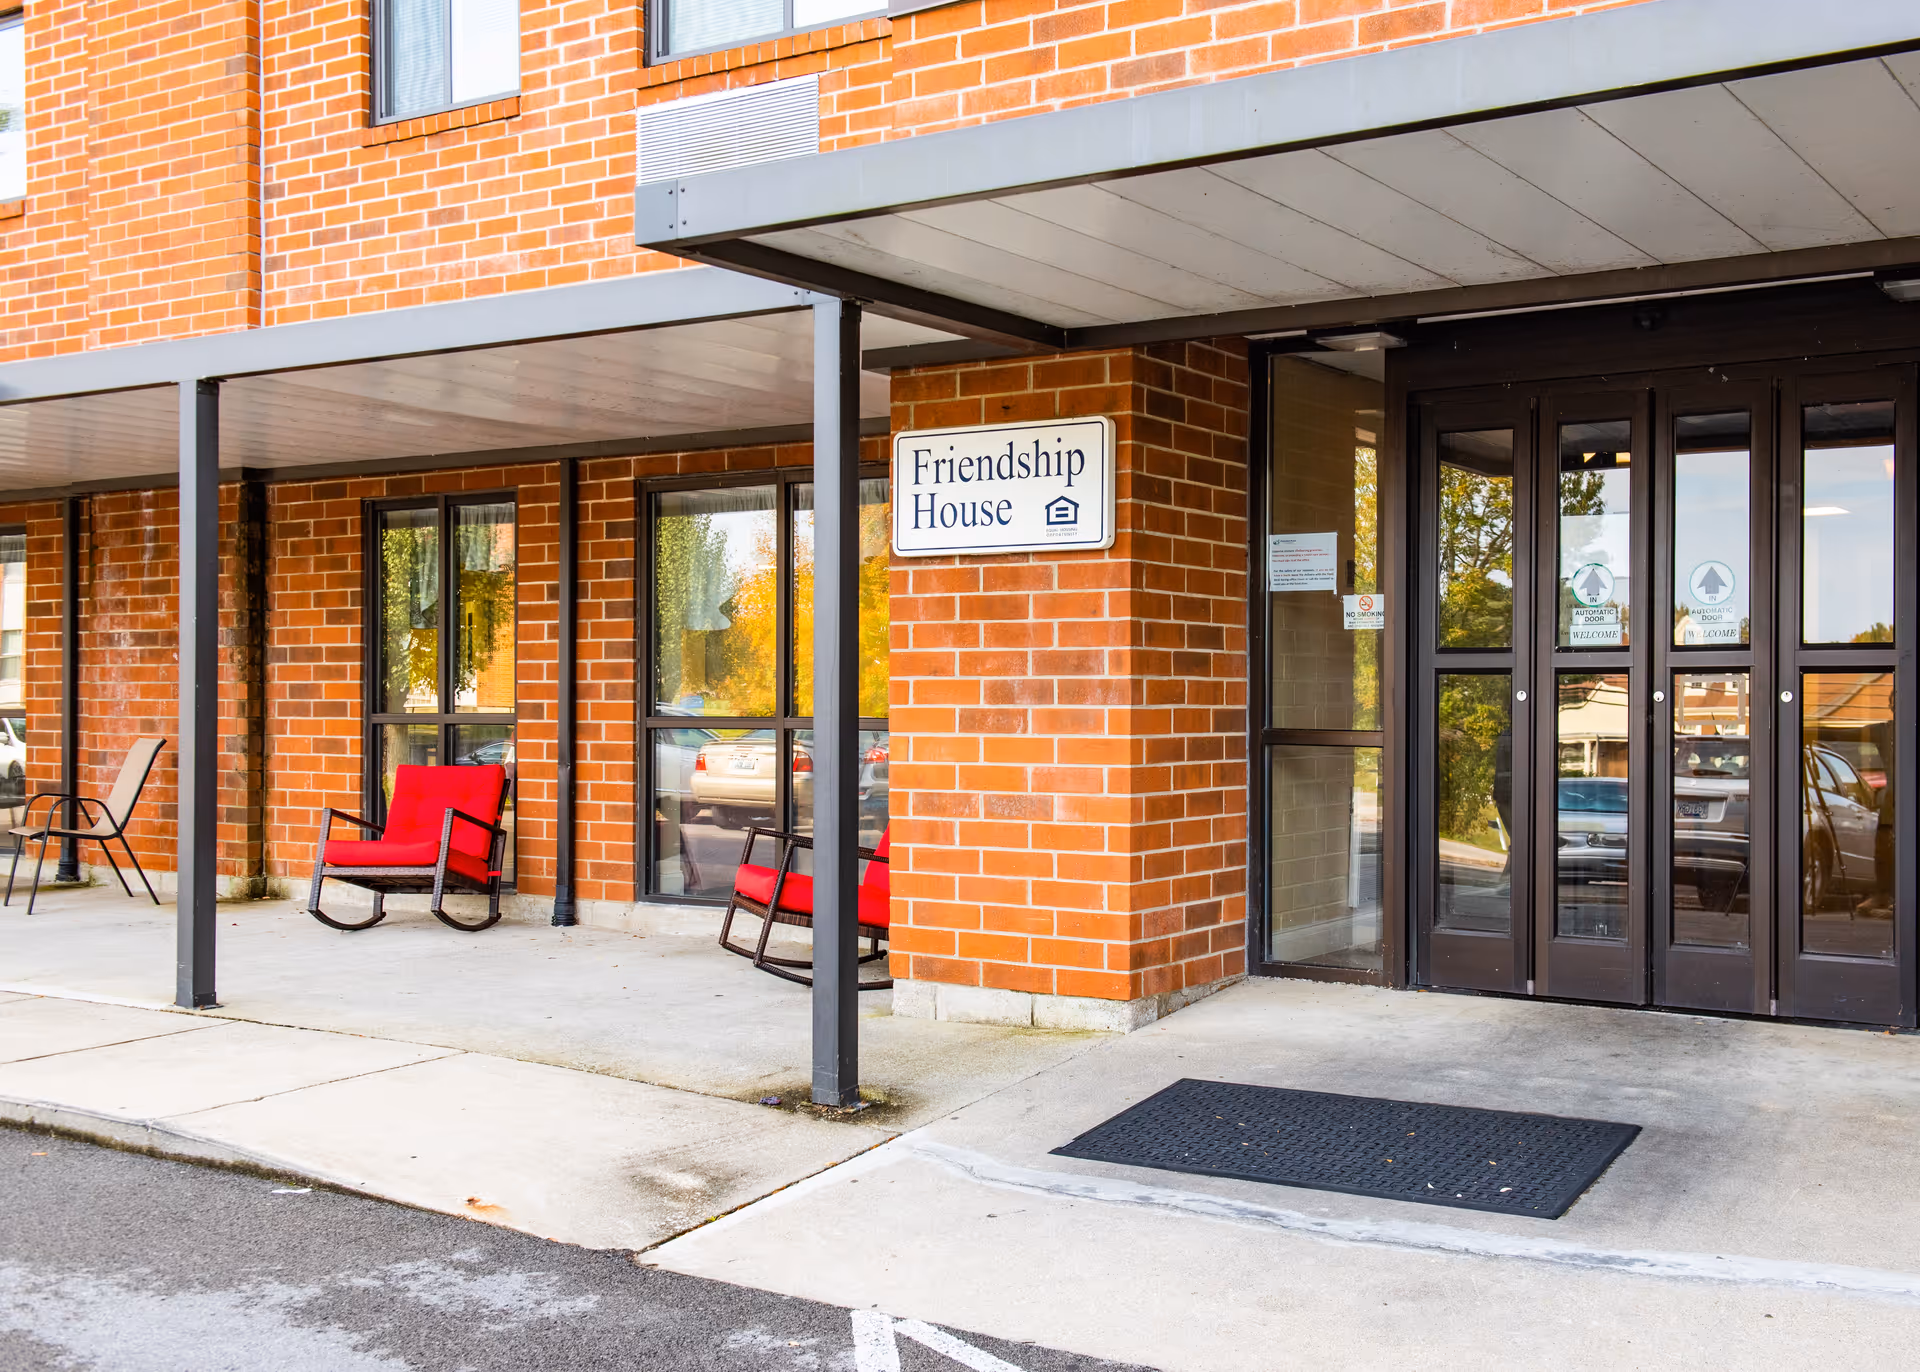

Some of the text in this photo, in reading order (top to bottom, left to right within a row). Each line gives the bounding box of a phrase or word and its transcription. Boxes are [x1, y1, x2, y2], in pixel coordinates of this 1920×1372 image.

[911, 437, 1085, 487] Friendship
[911, 493, 1013, 529] House
[1575, 608, 1615, 616] AUTOMATIC
[1691, 607, 1733, 615] AUTOMATIC
[1572, 630, 1619, 639] WELCOME
[1688, 628, 1737, 638] WELCOME
